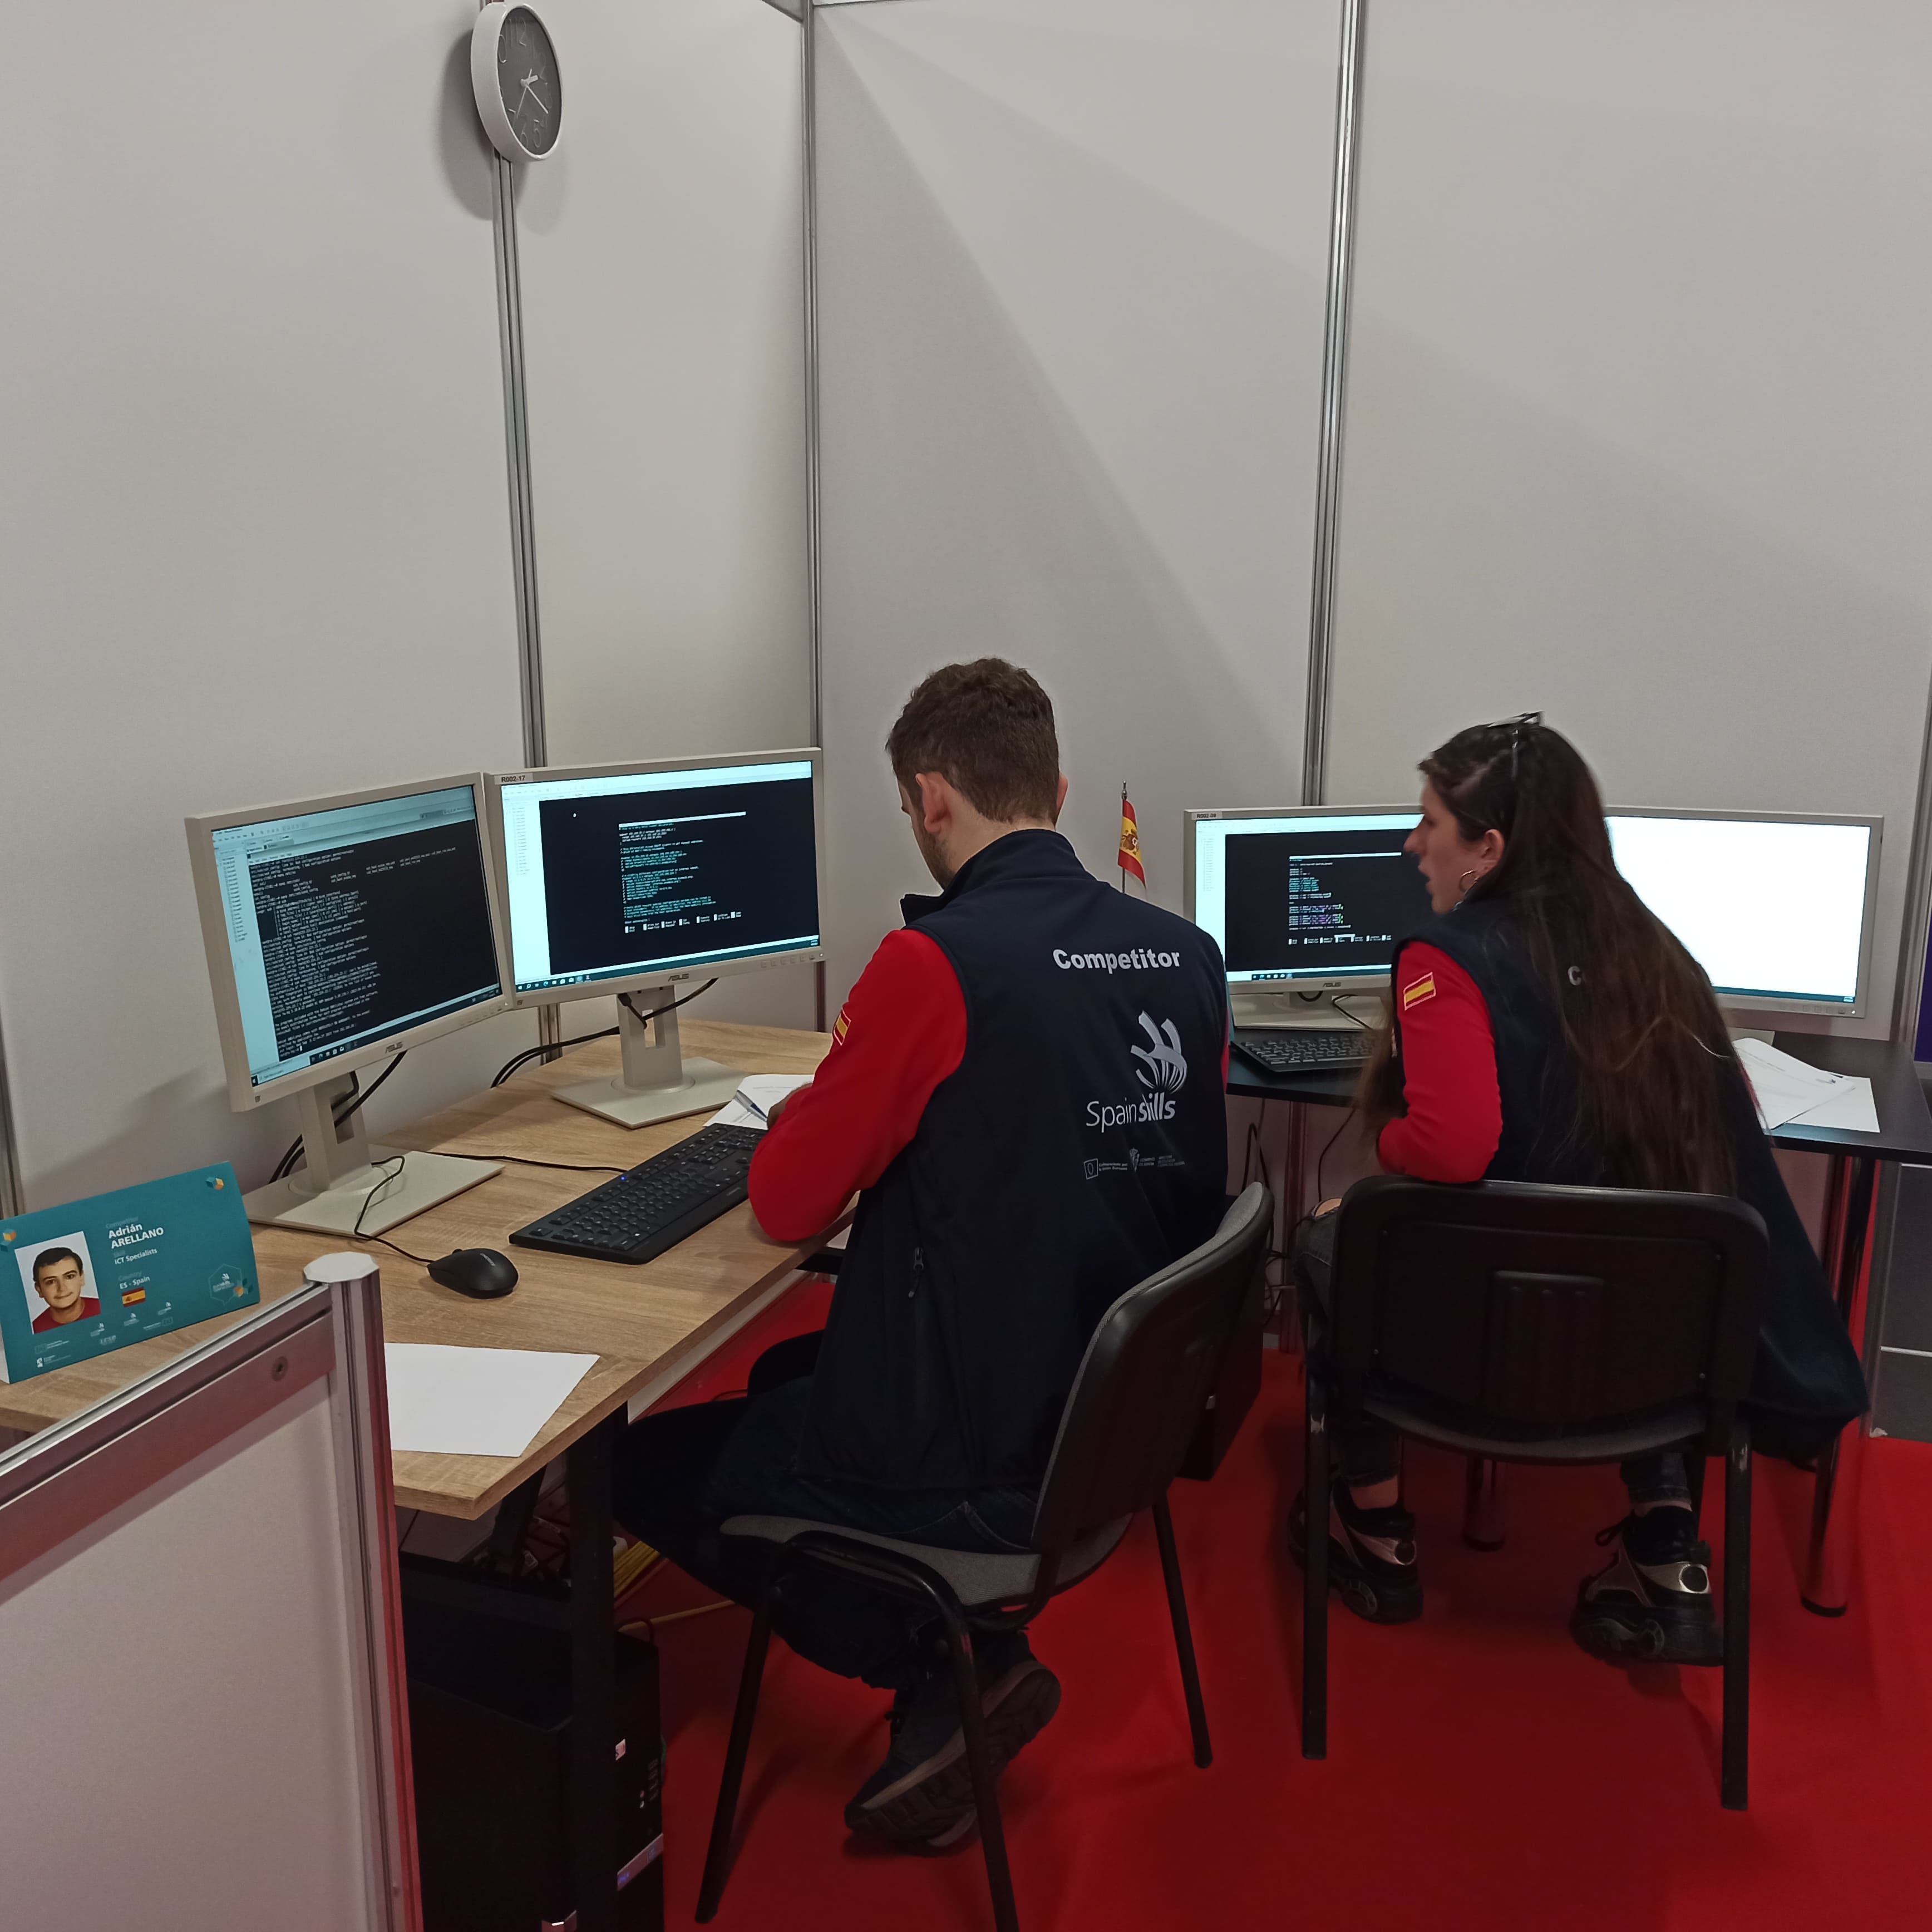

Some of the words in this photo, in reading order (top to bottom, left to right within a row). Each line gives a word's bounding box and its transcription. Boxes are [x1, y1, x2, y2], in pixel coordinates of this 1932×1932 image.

[1053, 948, 1180, 974] Competitor
[668, 973, 689, 982] ASUS
[109, 1224, 143, 1239] Adrián
[111, 1227, 164, 1249] ARELLANO
[114, 1256, 125, 1265] ICT
[126, 1248, 158, 1262] Specialists
[132, 1276, 151, 1286] Spain
